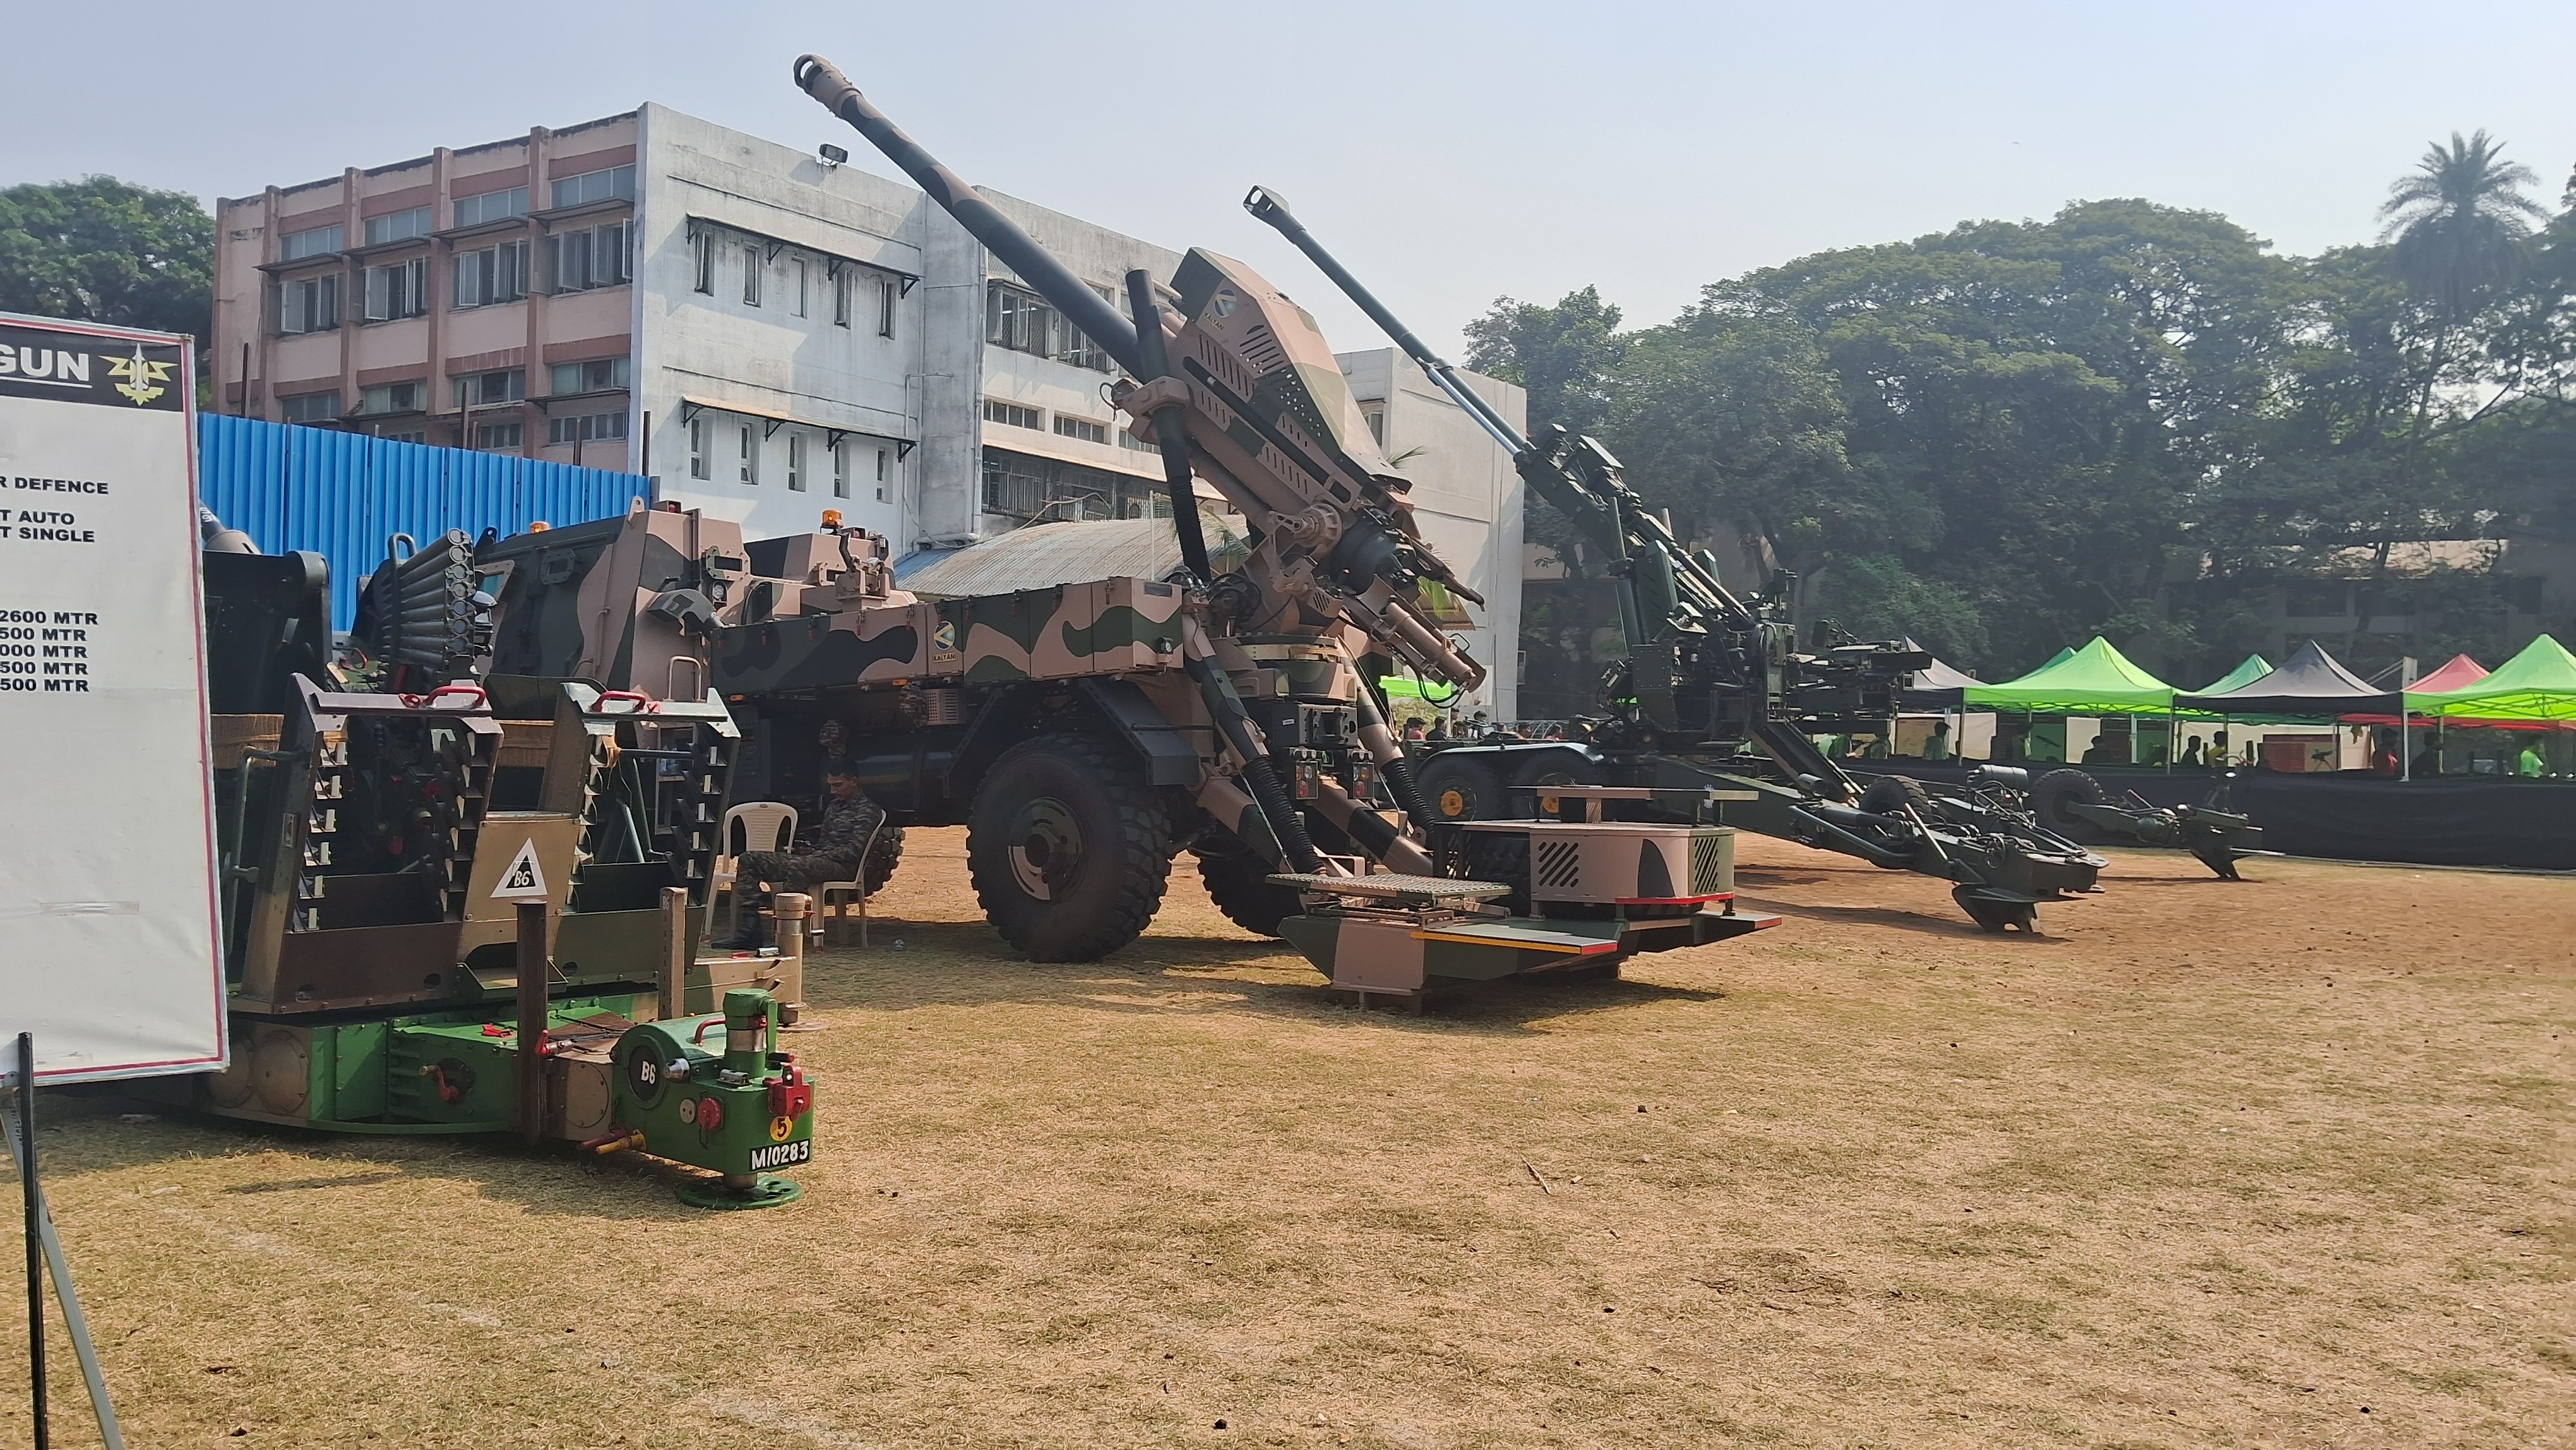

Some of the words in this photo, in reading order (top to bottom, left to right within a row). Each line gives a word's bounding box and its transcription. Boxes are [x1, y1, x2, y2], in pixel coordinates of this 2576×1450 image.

[15, 477, 109, 494] DEFENCE
[0, 510, 11, 521] T
[18, 510, 75, 525] AUTO
[0, 526, 11, 537] T
[19, 527, 95, 542] SINGLE
[54, 612, 99, 625] MTR
[0, 627, 35, 640] 500
[42, 628, 86, 641] MTR
[0, 644, 35, 657] 000
[43, 645, 88, 658] MTR
[933, 653, 957, 661] KALYANI
[0, 661, 35, 674] 500
[44, 662, 88, 675] MTR
[0, 678, 37, 691] 500
[44, 679, 89, 692] MTR
[513, 870, 531, 887] B6
[641, 1060, 656, 1085] B6
[777, 1118, 787, 1138] 5
